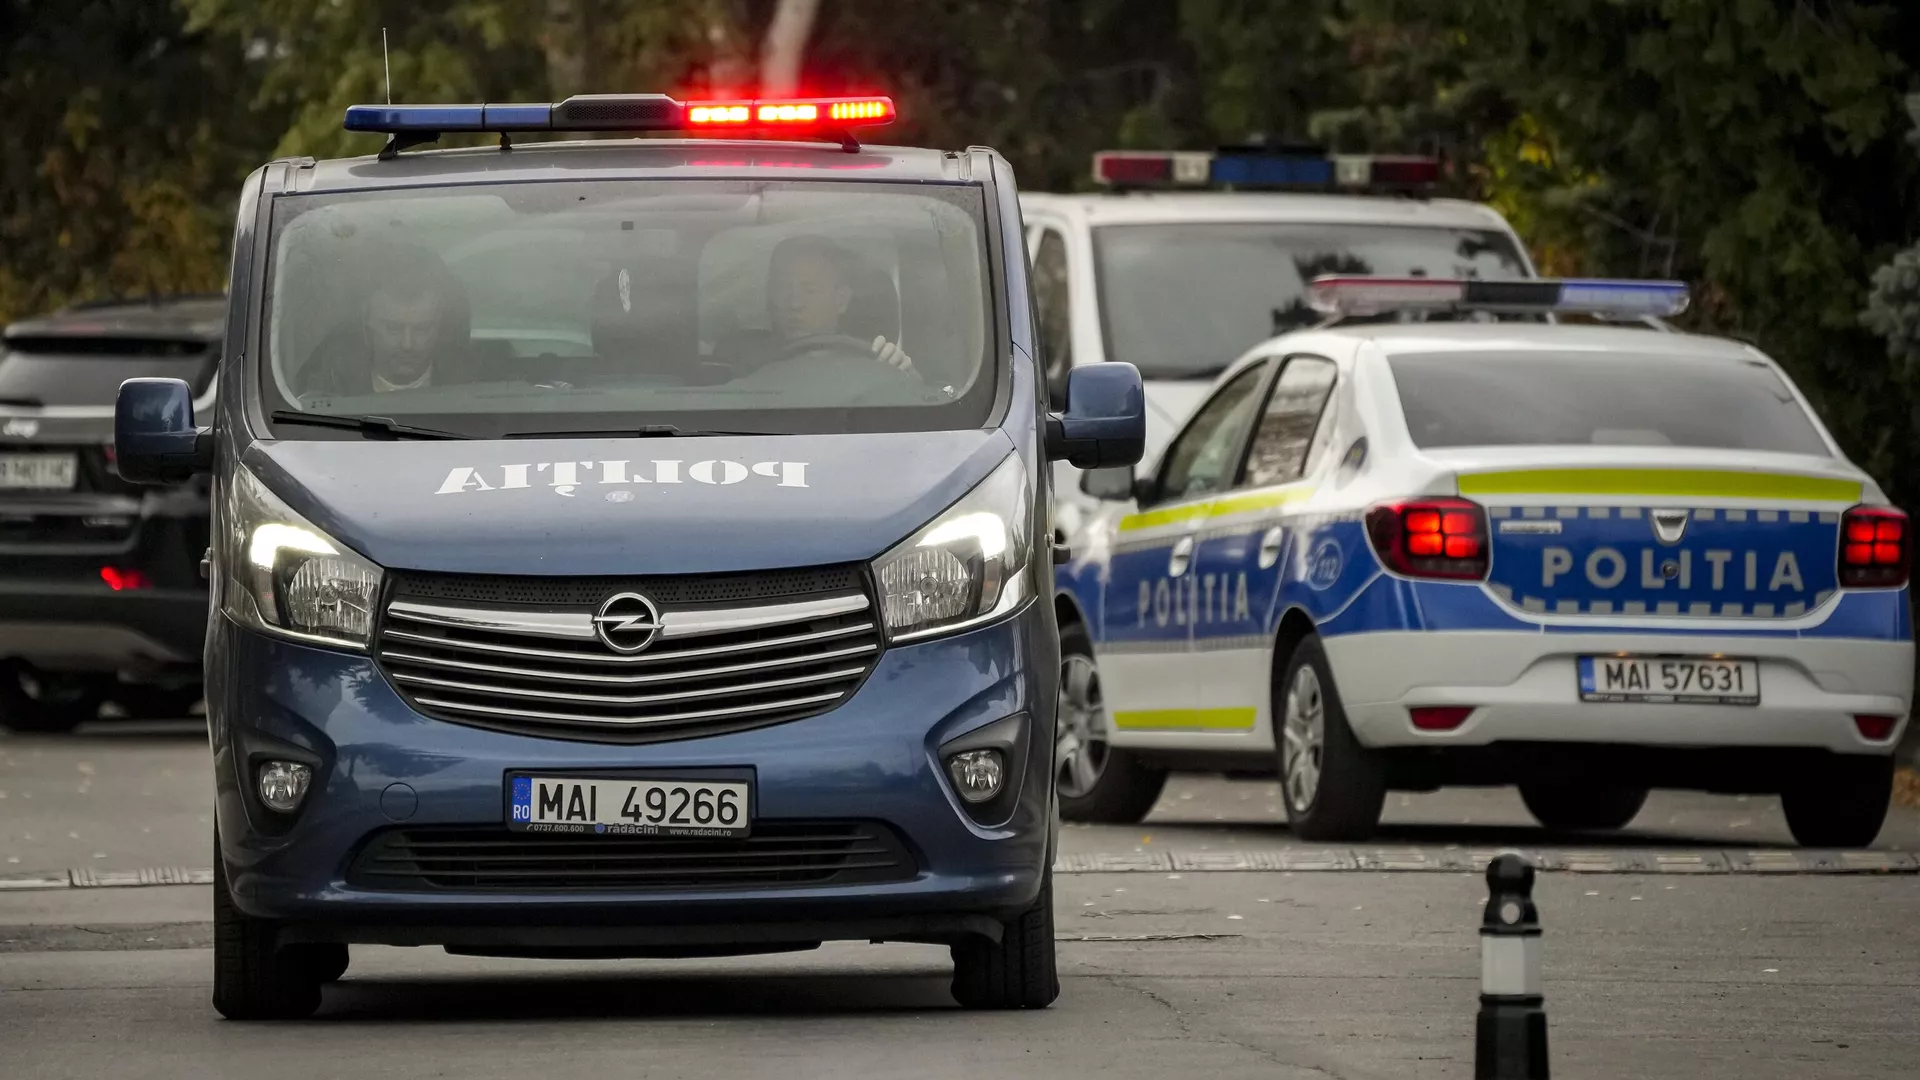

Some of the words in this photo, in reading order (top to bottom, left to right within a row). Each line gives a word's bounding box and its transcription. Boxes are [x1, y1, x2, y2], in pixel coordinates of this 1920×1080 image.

[1542, 548, 1804, 592] POLITIA
[1604, 663, 1651, 690] MAI
[1660, 664, 1744, 693] 57631
[513, 804, 530, 820] RO
[538, 783, 597, 822] MAI
[620, 786, 739, 826] 49266
[533, 824, 585, 833] 0737.600.600
